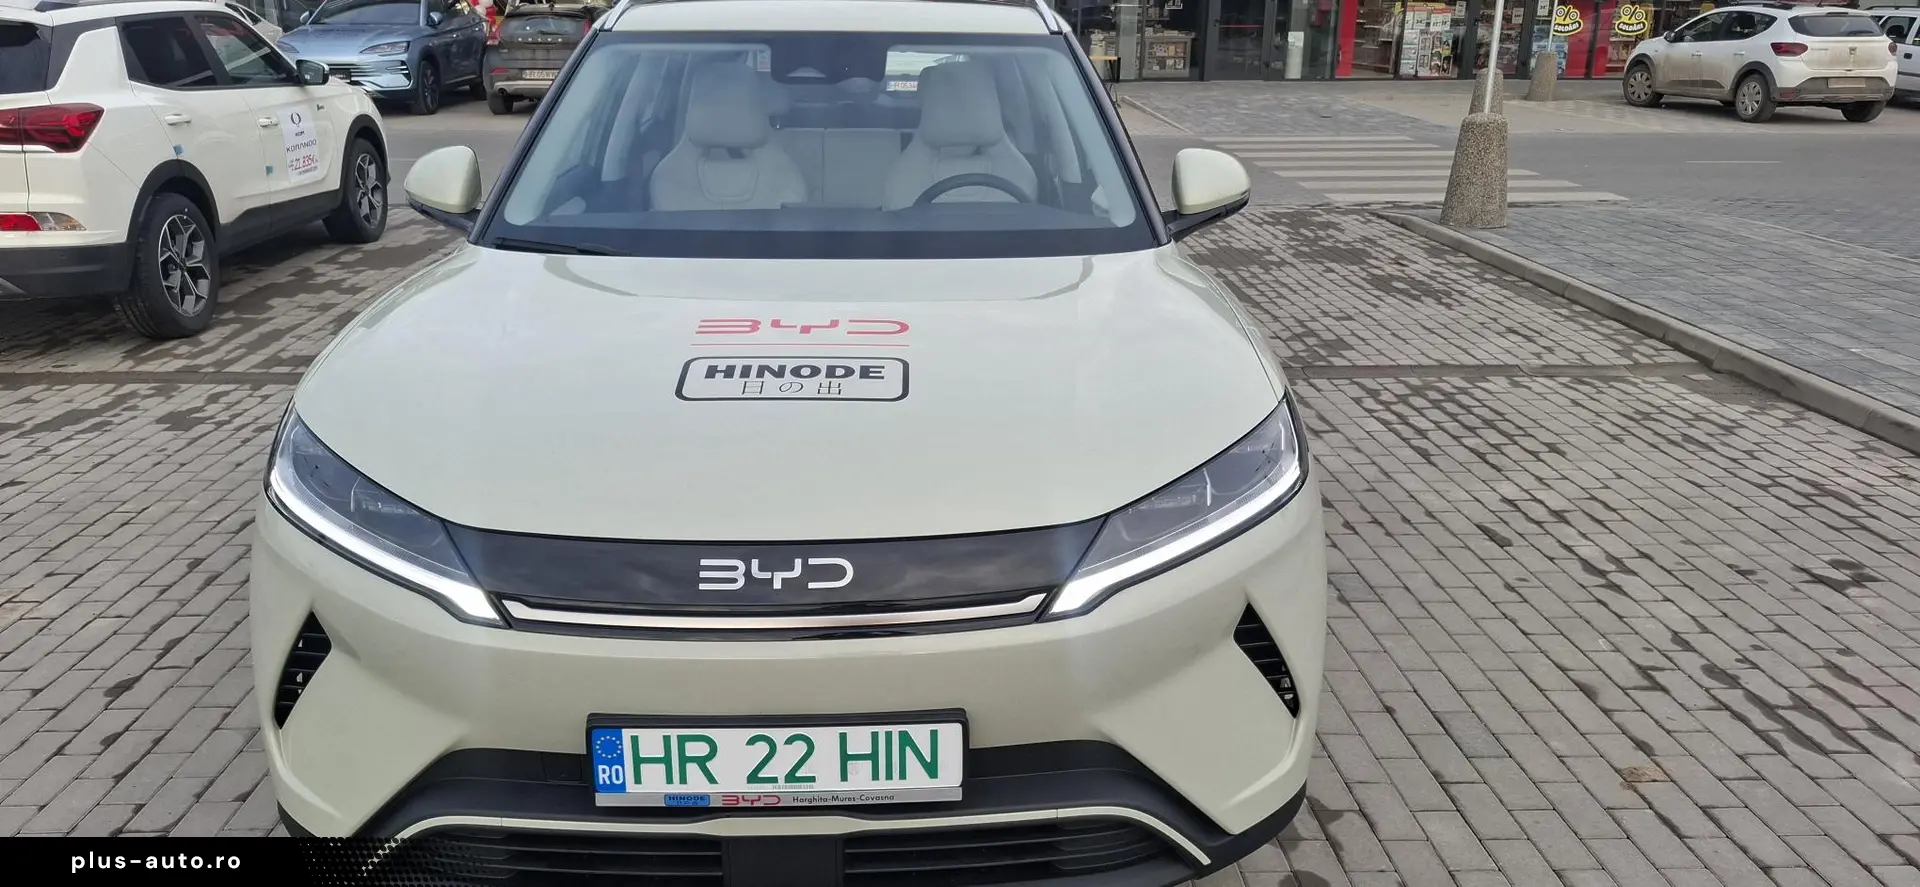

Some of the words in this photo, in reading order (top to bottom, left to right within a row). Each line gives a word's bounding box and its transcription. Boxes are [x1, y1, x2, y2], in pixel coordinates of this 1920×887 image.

[695, 319, 910, 335] BYD
[704, 365, 885, 379] HINODE
[742, 381, 842, 395] 日の出
[699, 557, 854, 590] BYD
[598, 765, 624, 785] RO
[630, 734, 719, 785] HR
[745, 733, 817, 784] 22
[838, 729, 939, 782] HIN
[721, 795, 781, 806] BYD
[792, 794, 895, 804] Harghita-Mures-Covasna
